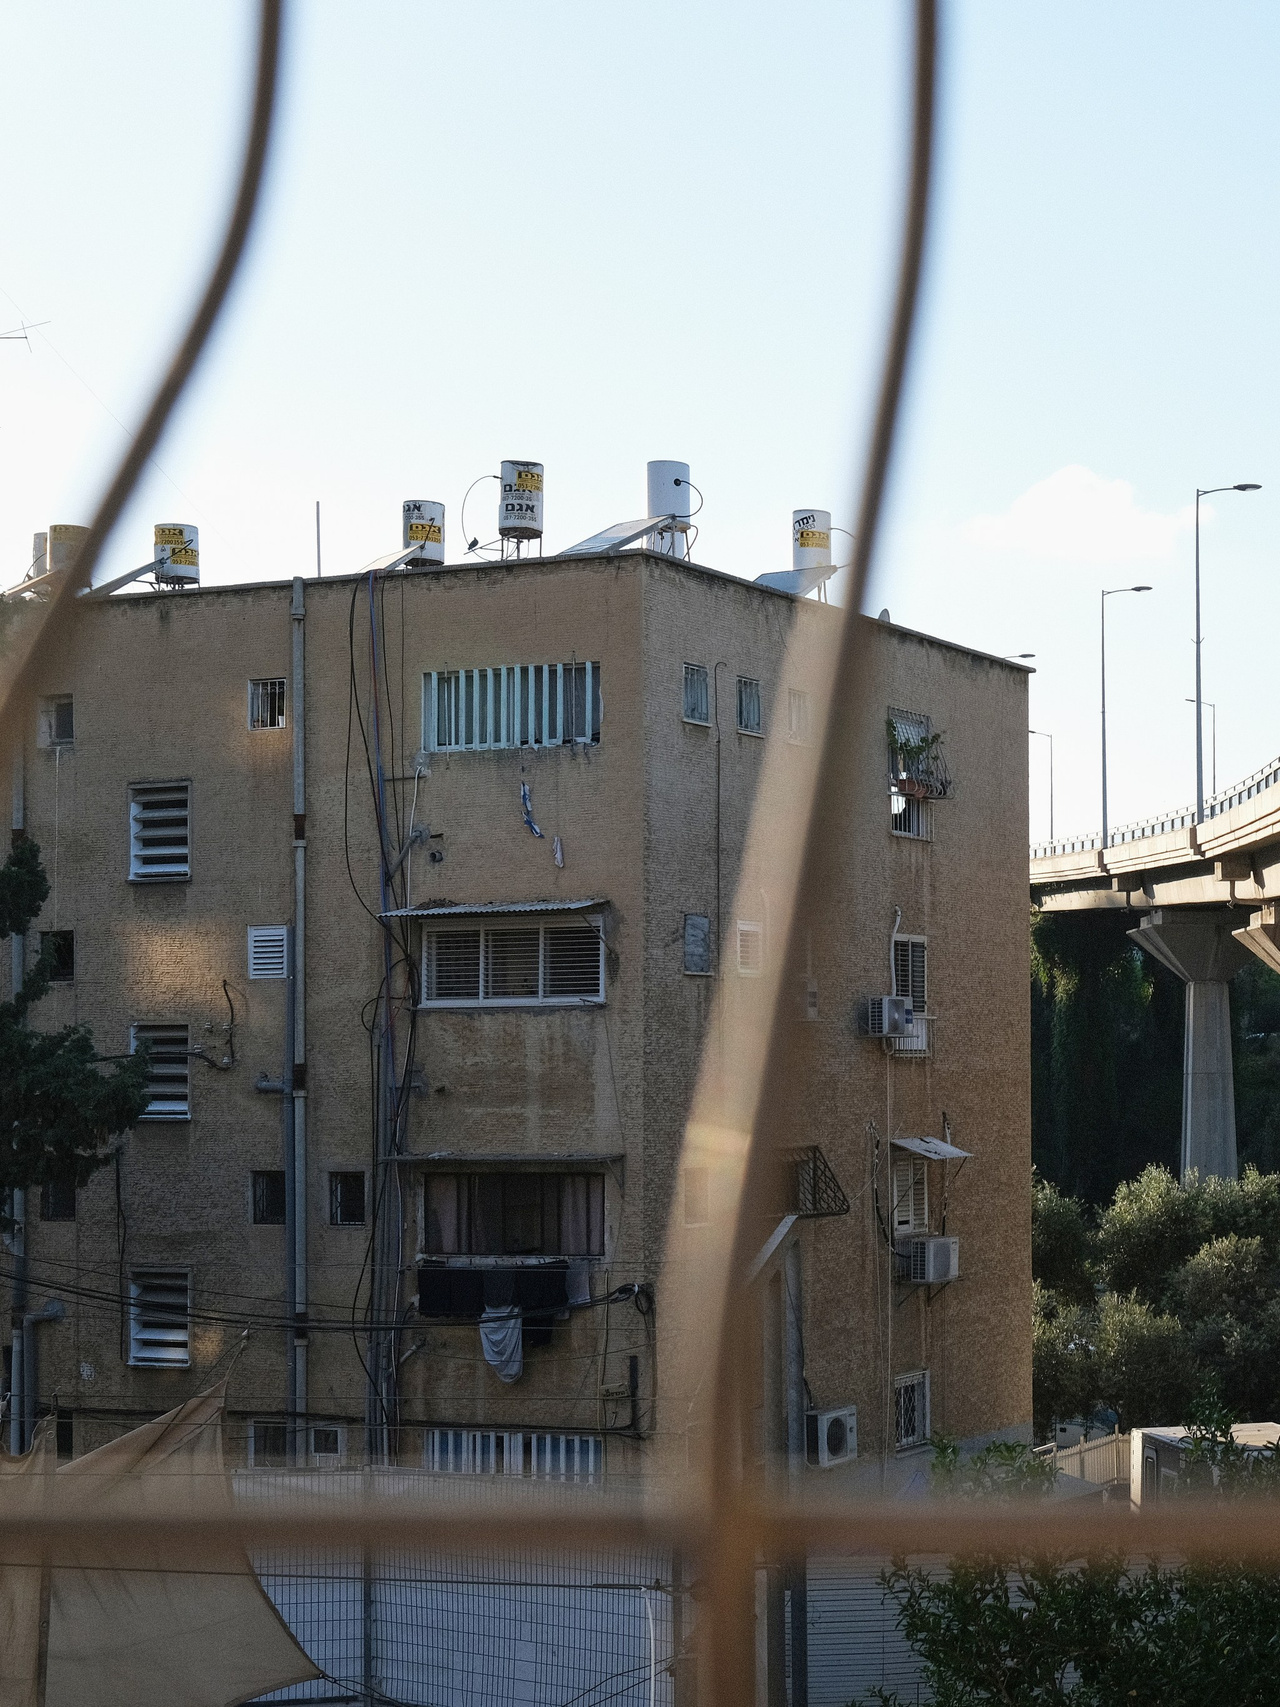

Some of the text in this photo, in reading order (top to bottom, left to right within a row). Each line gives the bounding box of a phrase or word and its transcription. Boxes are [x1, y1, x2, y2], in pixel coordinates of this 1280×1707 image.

[505, 503, 535, 513] אגם
[412, 524, 439, 533] אגם
[803, 531, 828, 539] אגם
